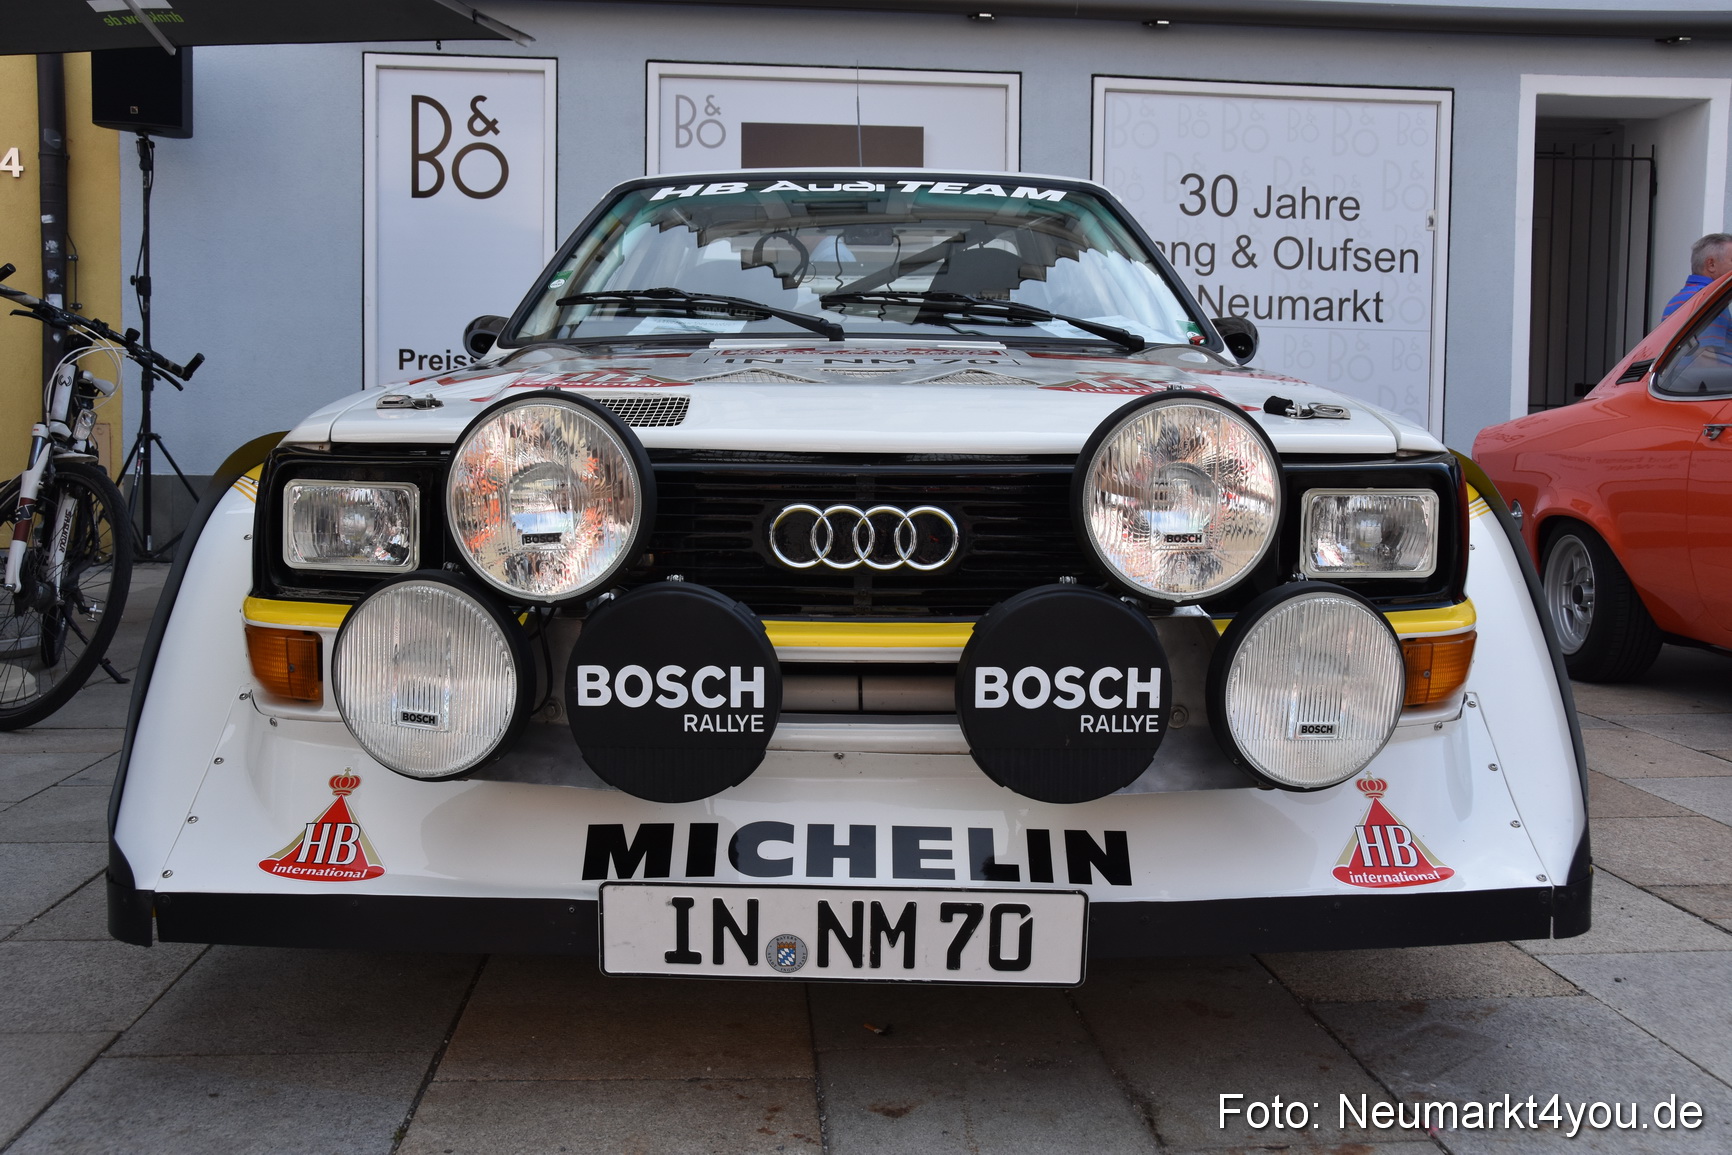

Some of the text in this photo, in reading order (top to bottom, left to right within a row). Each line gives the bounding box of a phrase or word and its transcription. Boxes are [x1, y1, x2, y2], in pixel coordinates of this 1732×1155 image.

[650, 180, 1067, 202] HB Audi TEAM
[1179, 173, 1361, 221] 30 Jahre
[1231, 234, 1258, 269] &
[1273, 236, 1419, 274] Olufsen
[1198, 284, 1384, 323] Neumarkt
[399, 348, 475, 371] Preis
[525, 533, 561, 544] BOSCH
[1166, 533, 1203, 544] BOSCH
[577, 664, 765, 708] BOSCH
[974, 666, 1161, 710] BOSCH
[402, 713, 436, 725] BOSCH
[684, 714, 764, 733] RALLYE
[1080, 714, 1159, 734] RALLYE
[1301, 724, 1334, 735] BOSCH
[295, 822, 361, 866] HB
[581, 820, 1133, 886] MICHELIN
[1354, 824, 1418, 869] HB
[272, 863, 368, 880] international
[1348, 869, 1441, 884] international
[664, 896, 1034, 972] IN NM 70
